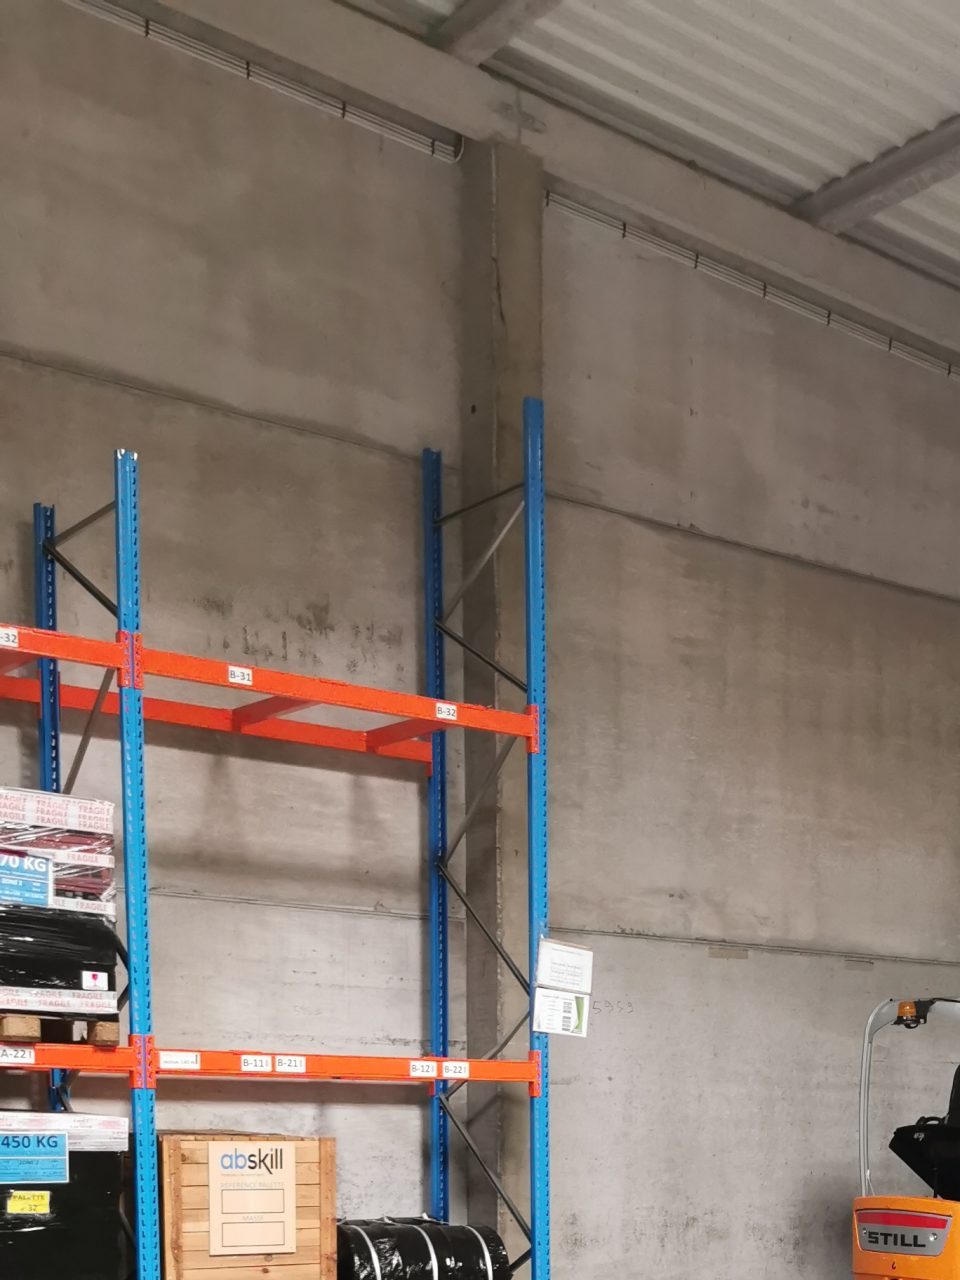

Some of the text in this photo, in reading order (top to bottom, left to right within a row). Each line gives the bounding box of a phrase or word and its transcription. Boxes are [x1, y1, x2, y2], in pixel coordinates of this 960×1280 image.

[0, 632, 17, 643] -32
[230, 670, 251, 681] B-31
[437, 706, 456, 717] B-32
[23, 856, 47, 872] KG
[243, 1058, 264, 1067] B-11
[277, 1058, 298, 1067] B-21
[411, 1064, 430, 1073] B-12
[444, 1065, 463, 1074] B-22
[1, 1135, 58, 1149] 450 KG
[220, 1148, 283, 1175] abskill
[868, 1230, 926, 1248] STILL
